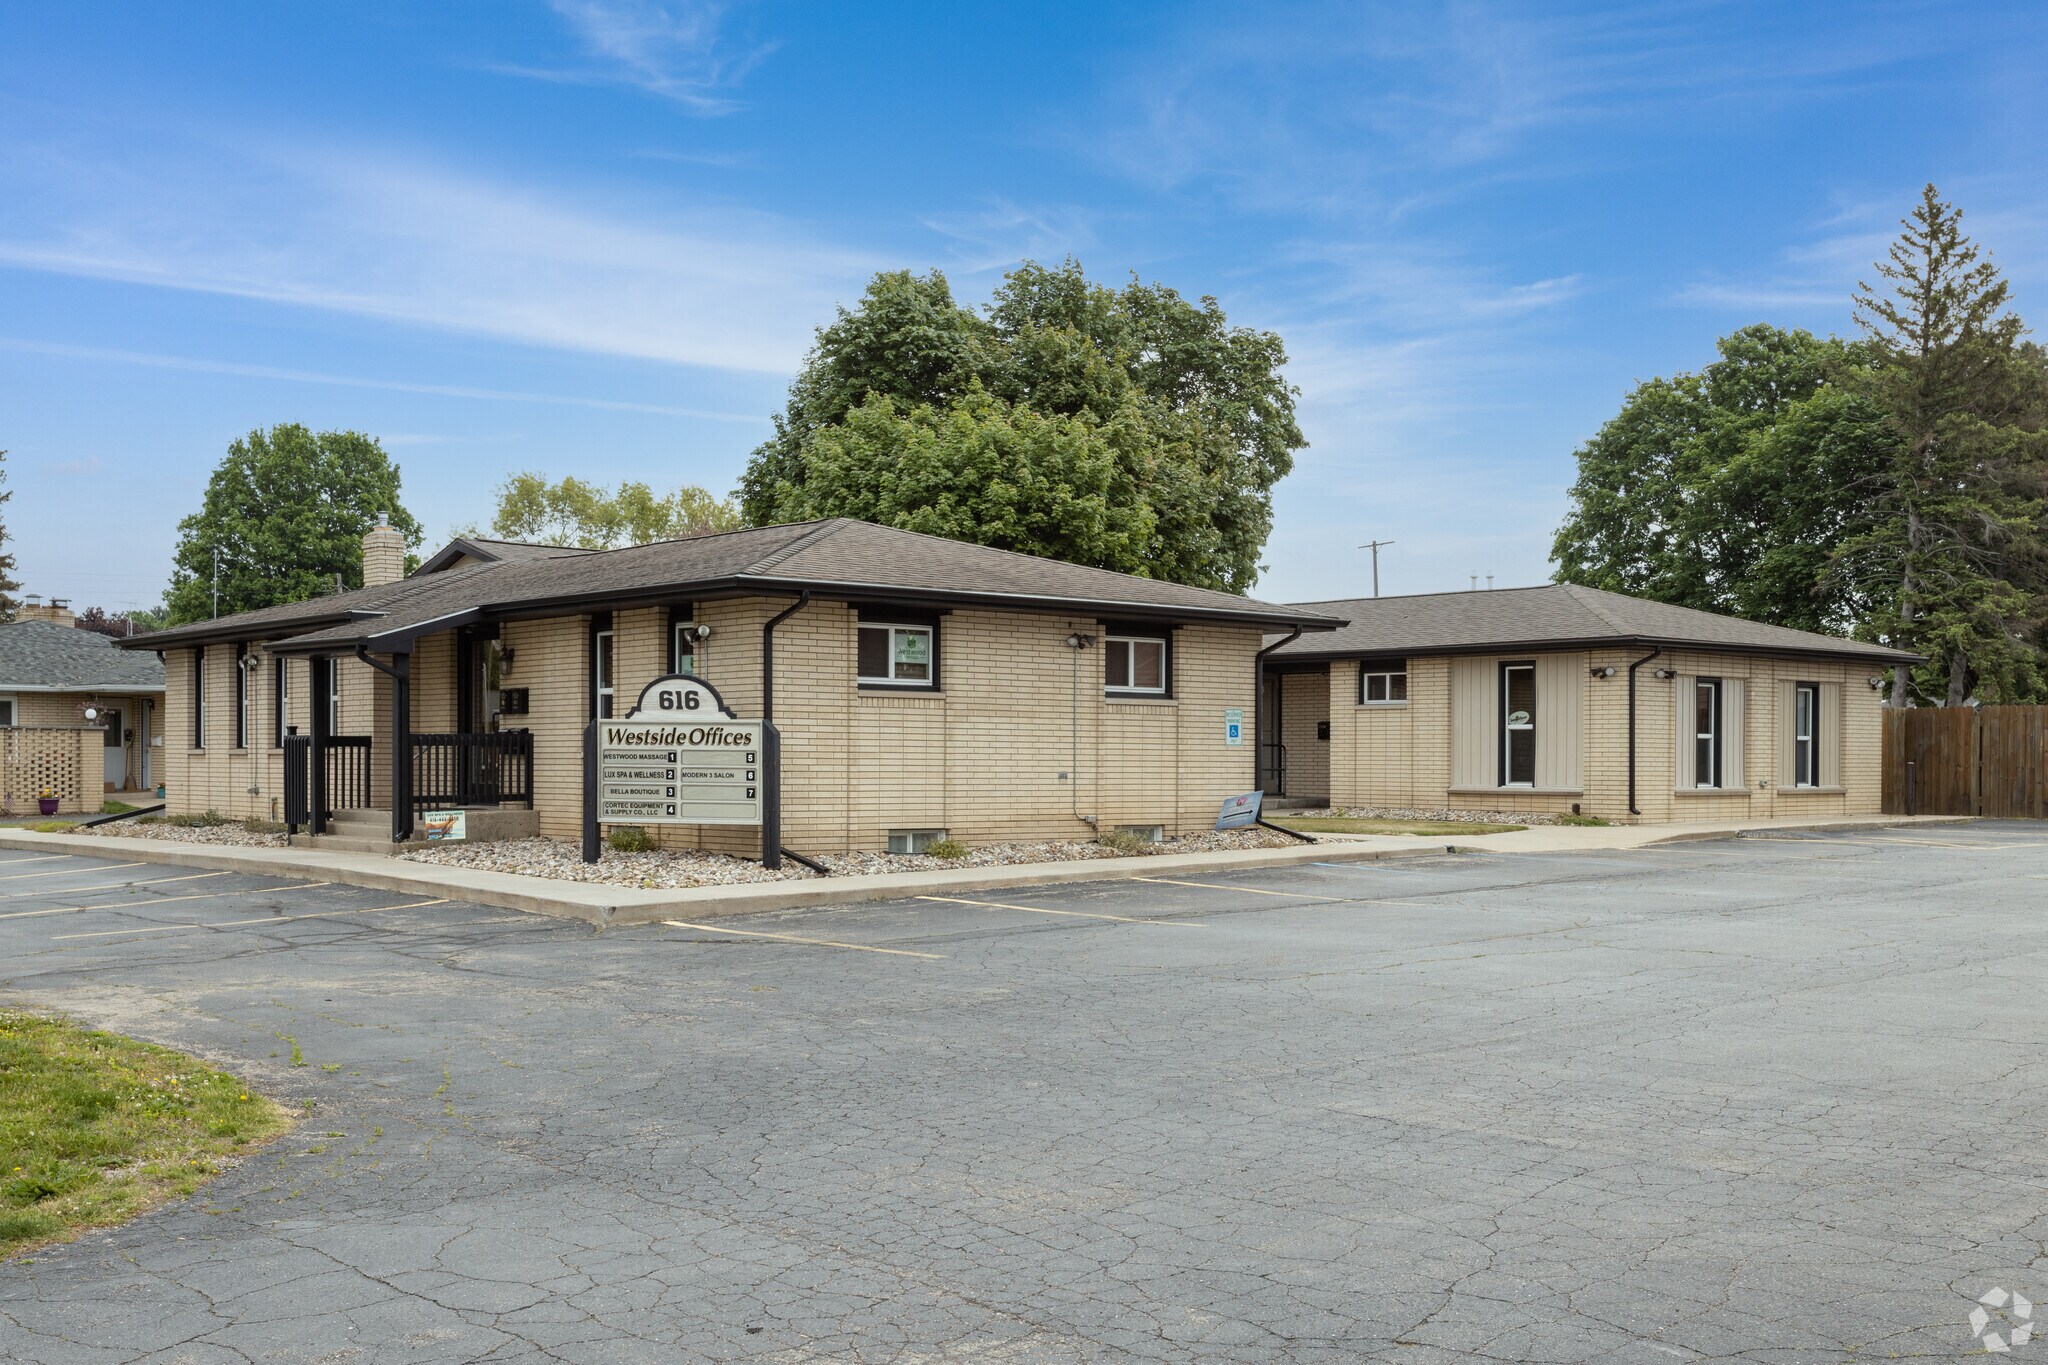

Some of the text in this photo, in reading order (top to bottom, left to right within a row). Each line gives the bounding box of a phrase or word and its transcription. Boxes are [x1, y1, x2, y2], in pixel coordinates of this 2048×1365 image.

[659, 690, 700, 710] 616
[608, 727, 752, 746] Westside Offices
[604, 771, 616, 779] LUX
[616, 771, 627, 779] SPA
[633, 771, 665, 779] WELLNESS
